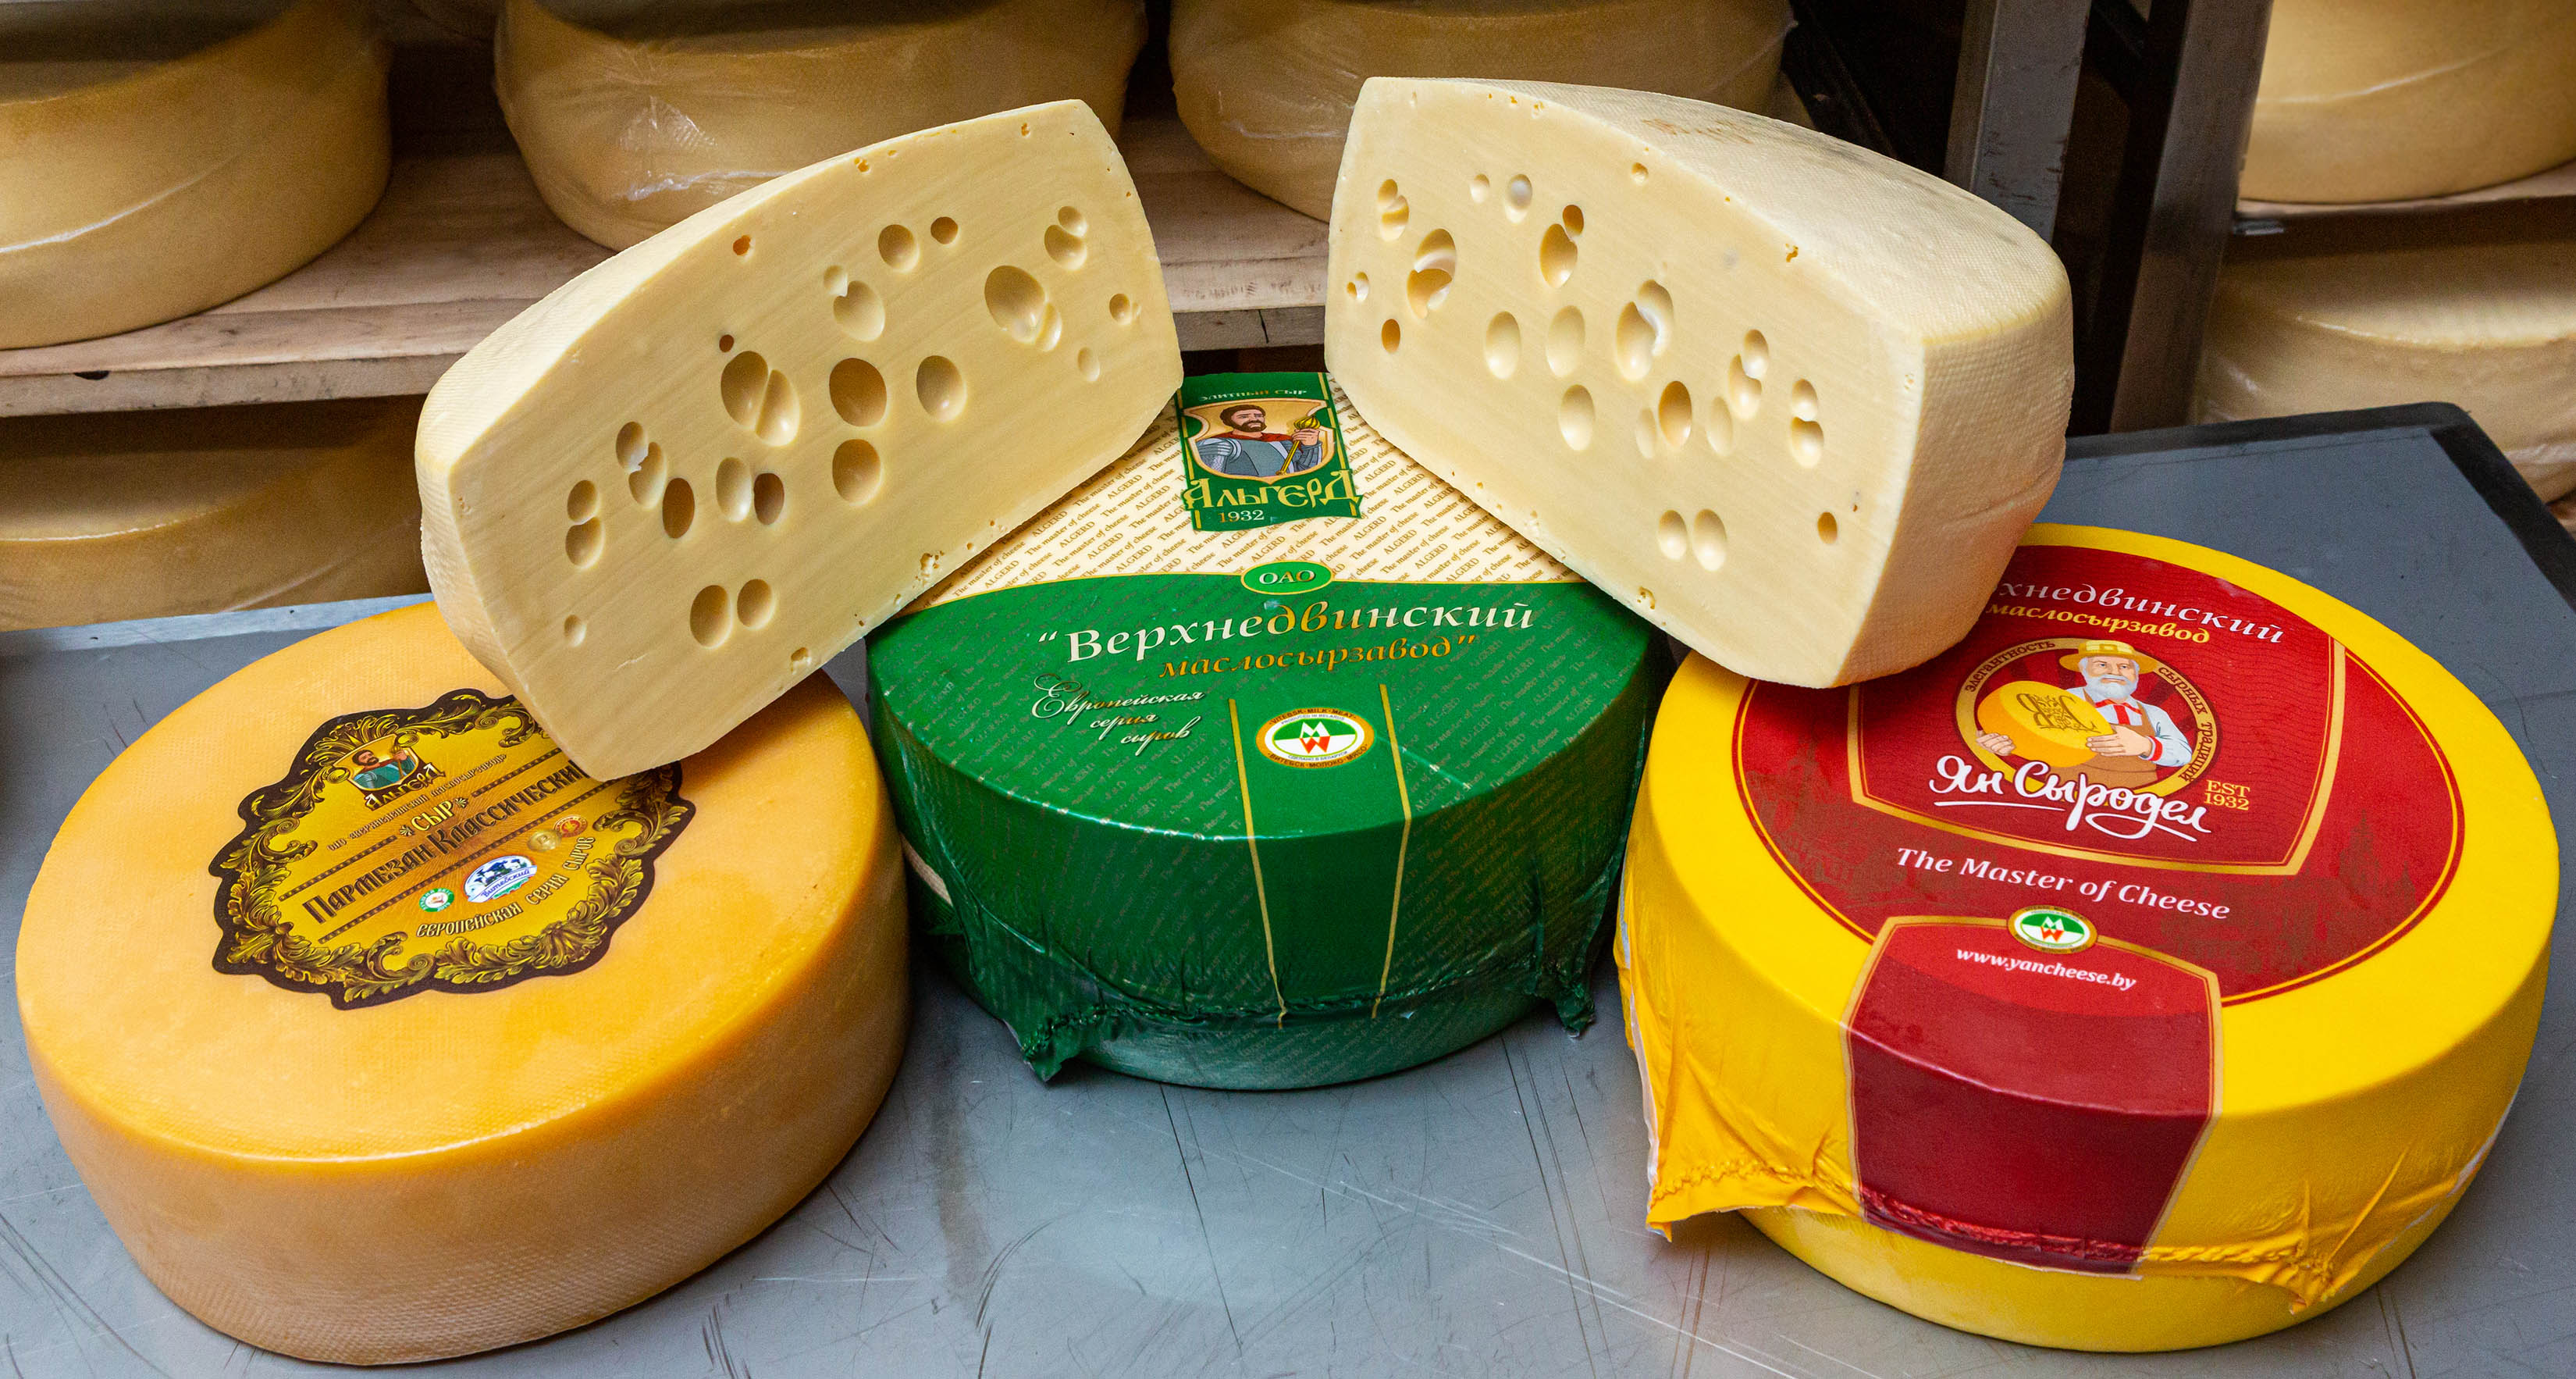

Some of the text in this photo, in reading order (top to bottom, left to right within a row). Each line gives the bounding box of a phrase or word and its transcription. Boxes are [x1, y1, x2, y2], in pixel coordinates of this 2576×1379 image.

[1153, 437, 1179, 455] ALGER
[1349, 433, 1370, 447] cheese
[1147, 450, 1182, 472] The mast
[1364, 460, 1397, 483] ALGERD
[1074, 496, 1088, 507] The
[1091, 478, 1118, 496] master
[1124, 458, 1147, 475] cheese
[1100, 506, 1118, 518] The
[1118, 489, 1143, 508] master
[1151, 469, 1175, 486] cheese
[1107, 474, 1143, 501] ALGERD
[1375, 474, 1400, 492] master
[1393, 472, 1425, 495] ALGERD
[1135, 485, 1170, 511] ALGERD
[1390, 481, 1437, 512] The master of
[1032, 511, 1067, 537] ALGERD
[1129, 518, 1147, 530] The
[1147, 500, 1170, 518] master
[1219, 510, 1265, 523] 1932
[1319, 537, 1336, 547] The
[1336, 518, 1359, 537] master
[1368, 498, 1389, 514] cheese
[1421, 495, 1468, 527] The master of
[1025, 503, 1101, 557] The master of cheese
[1059, 521, 1095, 548] ALGERD
[1158, 530, 1174, 542] The
[1290, 522, 1305, 533] The
[1349, 549, 1366, 561] The
[1366, 533, 1389, 551] master
[1397, 511, 1419, 528] cheese
[1353, 515, 1387, 541] ALGERD
[1451, 530, 1466, 541] The
[1053, 514, 1130, 568] The master of cheese
[1087, 532, 1123, 560] ALGERD
[1098, 548, 1123, 568] master
[1125, 542, 1133, 551] of
[1133, 526, 1158, 544] cheese
[1162, 538, 1187, 556] cheese
[1187, 543, 1203, 555] The
[1217, 532, 1267, 568] The master of
[1251, 536, 1286, 563] ALGERD
[1288, 530, 1318, 554] of cheese
[1325, 543, 1349, 562] cheese
[1380, 525, 1449, 575] The master of cheese
[1382, 529, 1418, 555] ALGERD
[1482, 544, 1497, 556] The
[952, 540, 1025, 597] The master of cheese
[1020, 551, 1052, 577] of cheese
[1116, 545, 1153, 572] ALGERD
[1190, 552, 1215, 569] cheese
[1356, 557, 1379, 576] cheese
[1414, 543, 1448, 569] ALGERD
[1427, 540, 1480, 579] master of cheese
[1482, 554, 1512, 576] of cheese
[1514, 560, 1530, 570] The
[984, 560, 1019, 589] ALGERD
[1259, 570, 1315, 585] ОАО
[1446, 558, 1479, 581] ALGERD
[1986, 603, 2210, 643] маслосырзавод
[1999, 583, 2285, 643] хнедвинский
[1031, 673, 1204, 725] Европейская
[1090, 713, 1158, 740] серия
[1121, 716, 1202, 756] сыров
[1928, 754, 2212, 843] Ян Сыродел
[2206, 779, 2250, 798] EST
[2204, 793, 2249, 811] 1932
[411, 800, 454, 831] СЫР
[1897, 847, 1953, 873] The
[1959, 858, 2073, 889] Master
[2080, 880, 2118, 903] of
[2118, 885, 2230, 919] Cheese
[1957, 948, 2137, 990] www.yancheese.by
